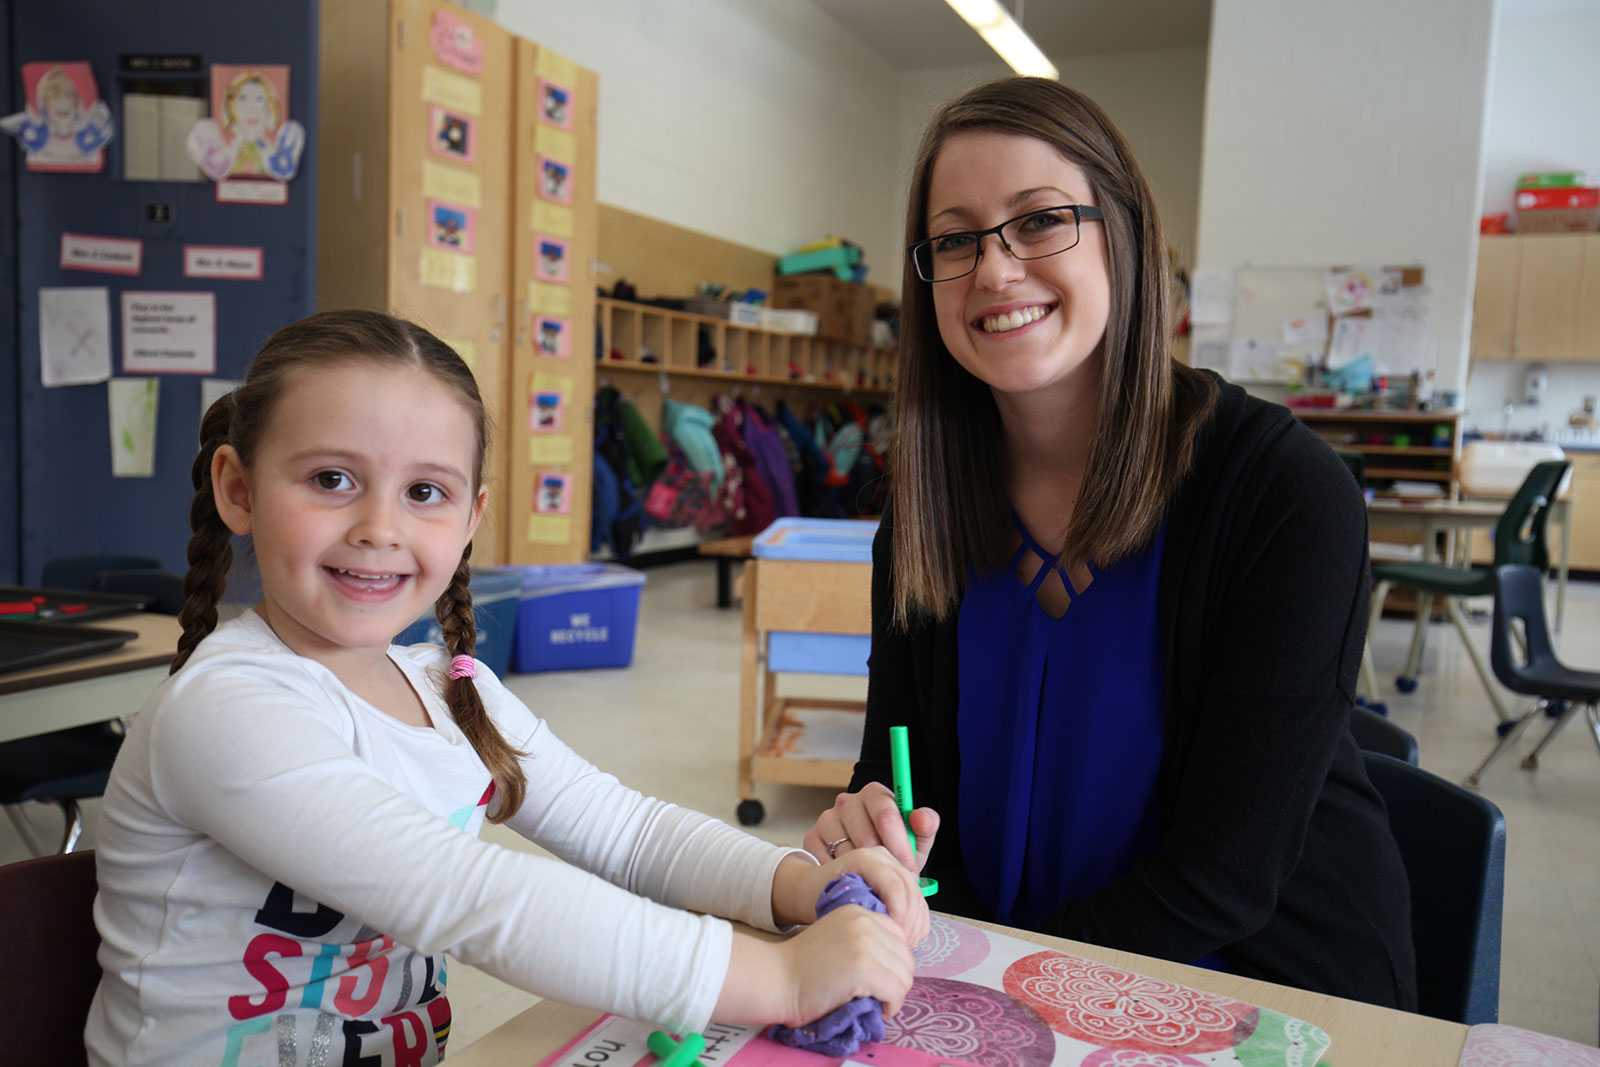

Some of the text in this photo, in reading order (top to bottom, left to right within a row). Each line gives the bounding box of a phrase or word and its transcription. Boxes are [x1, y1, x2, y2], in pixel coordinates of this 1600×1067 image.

[570, 612, 591, 626] WE
[549, 627, 608, 645] RECYCLE
[698, 1022, 748, 1061] littl
